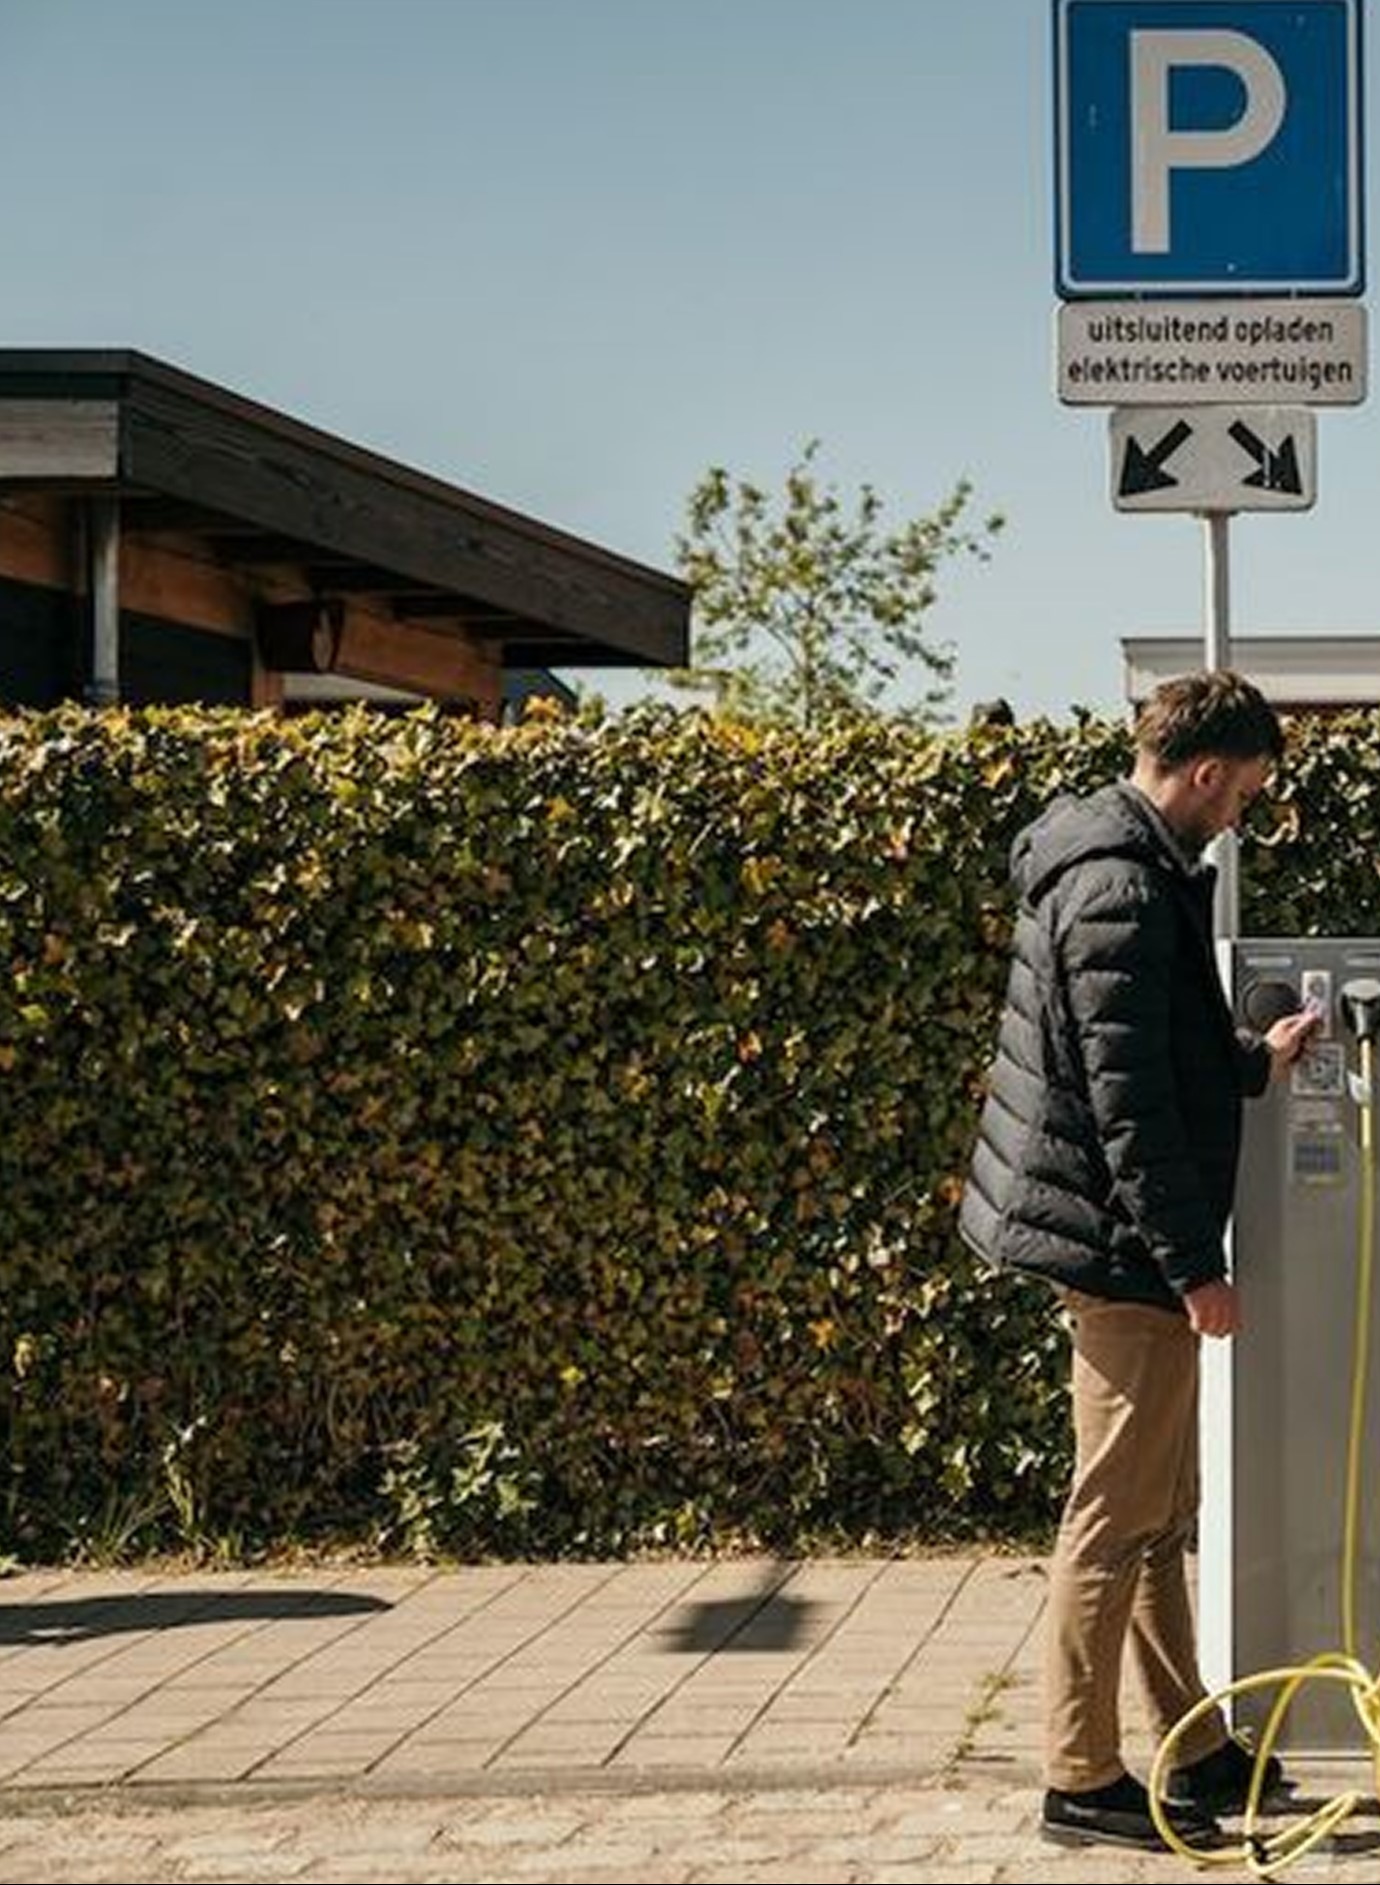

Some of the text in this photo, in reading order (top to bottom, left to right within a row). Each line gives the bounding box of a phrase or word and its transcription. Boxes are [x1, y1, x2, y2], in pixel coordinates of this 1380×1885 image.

[1130, 29, 1287, 253] P
[1088, 316, 1334, 345] uitsluitend opladen
[1067, 356, 1353, 390] elektrische voertuigen
